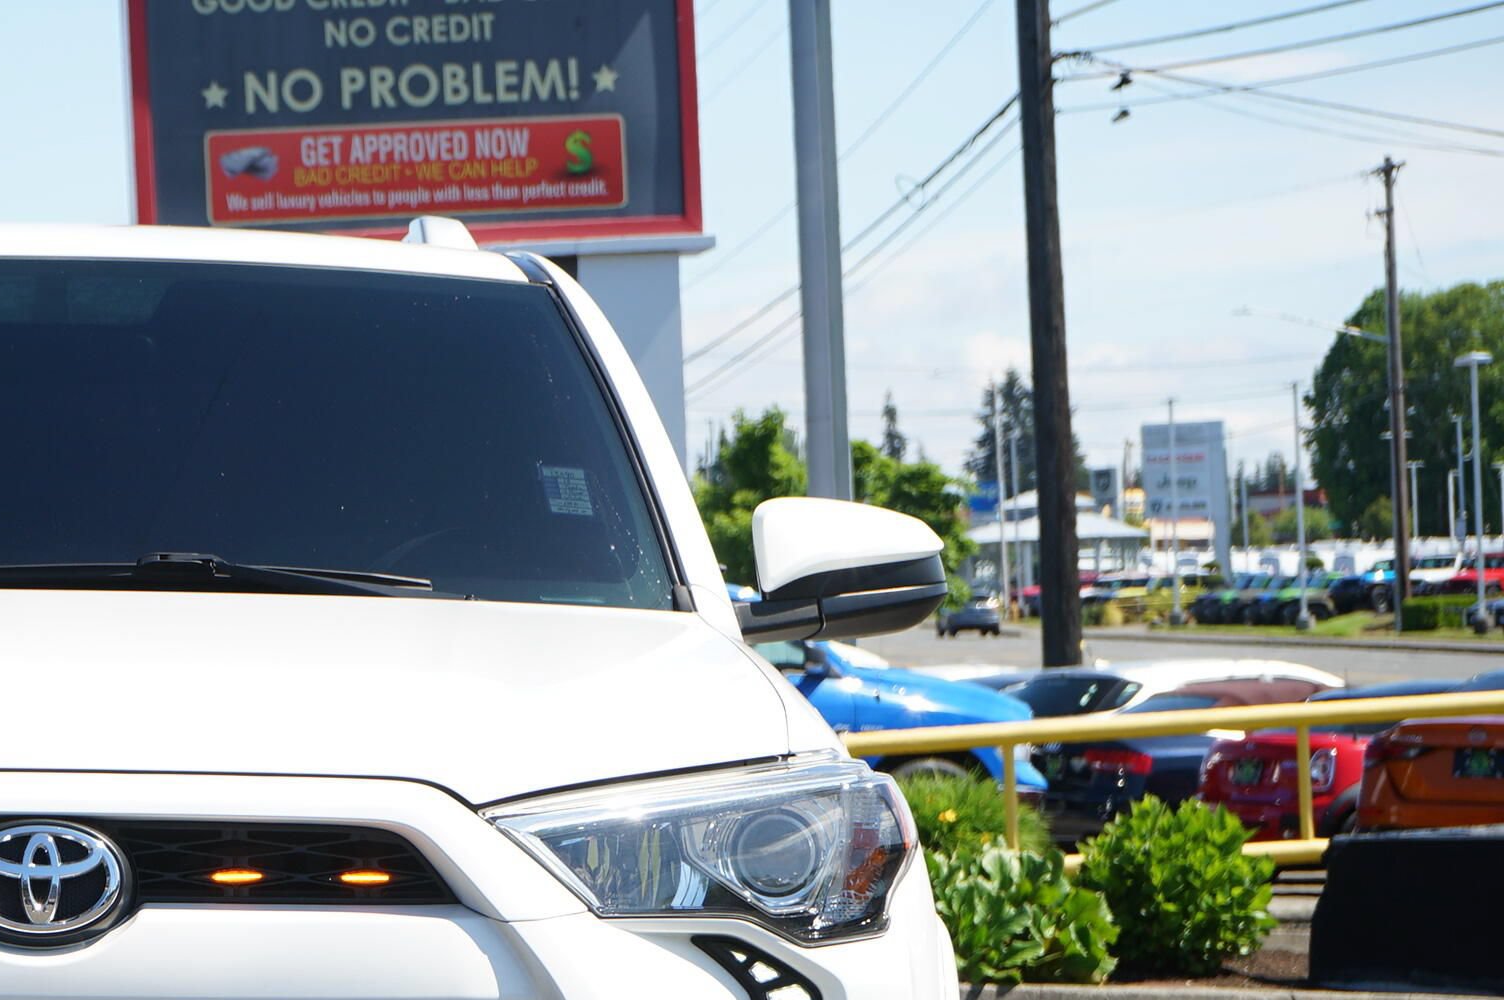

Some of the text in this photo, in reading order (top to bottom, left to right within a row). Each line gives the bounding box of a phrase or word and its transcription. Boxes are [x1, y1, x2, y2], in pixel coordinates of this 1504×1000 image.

[324, 13, 494, 48] NO CREDIT
[244, 57, 580, 114] NO PROBLEM!
[301, 127, 530, 167] GET APPROVED NOW
[294, 157, 539, 187] BAD CREDIT WE CAN HELP
[226, 192, 248, 211] We
[251, 191, 274, 210] sell
[277, 191, 315, 212] luxury
[318, 188, 370, 207] vehicles
[372, 189, 385, 205] to
[388, 185, 430, 209] people
[433, 182, 460, 202] with
[463, 183, 489, 201] less
[492, 181, 518, 200] than
[522, 179, 565, 204] perfect
